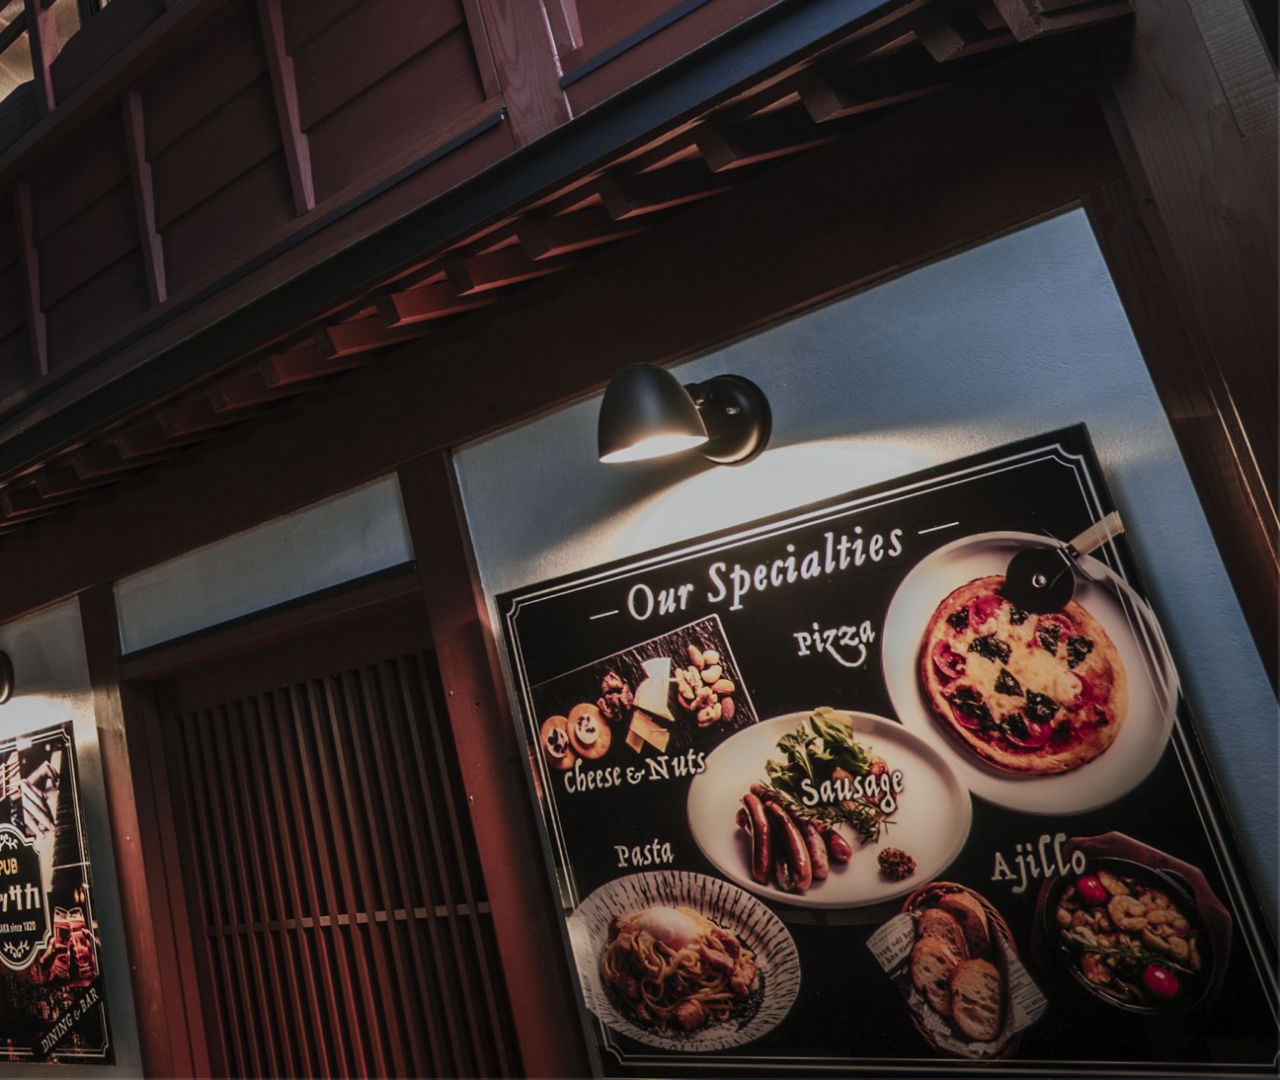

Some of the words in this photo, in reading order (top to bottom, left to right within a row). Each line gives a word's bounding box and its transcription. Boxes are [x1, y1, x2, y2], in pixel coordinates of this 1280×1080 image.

[627, 581, 694, 621] Our
[707, 526, 904, 611] Specialties
[793, 620, 876, 667] Pizza
[801, 771, 903, 813] Sausage
[614, 838, 675, 868] Pasta
[991, 832, 1085, 893] Ajillo
[10, 922, 23, 933] since
[23, 921, 37, 932] 1820
[41, 1012, 73, 1053] DINING
[80, 987, 100, 1013] BAR
